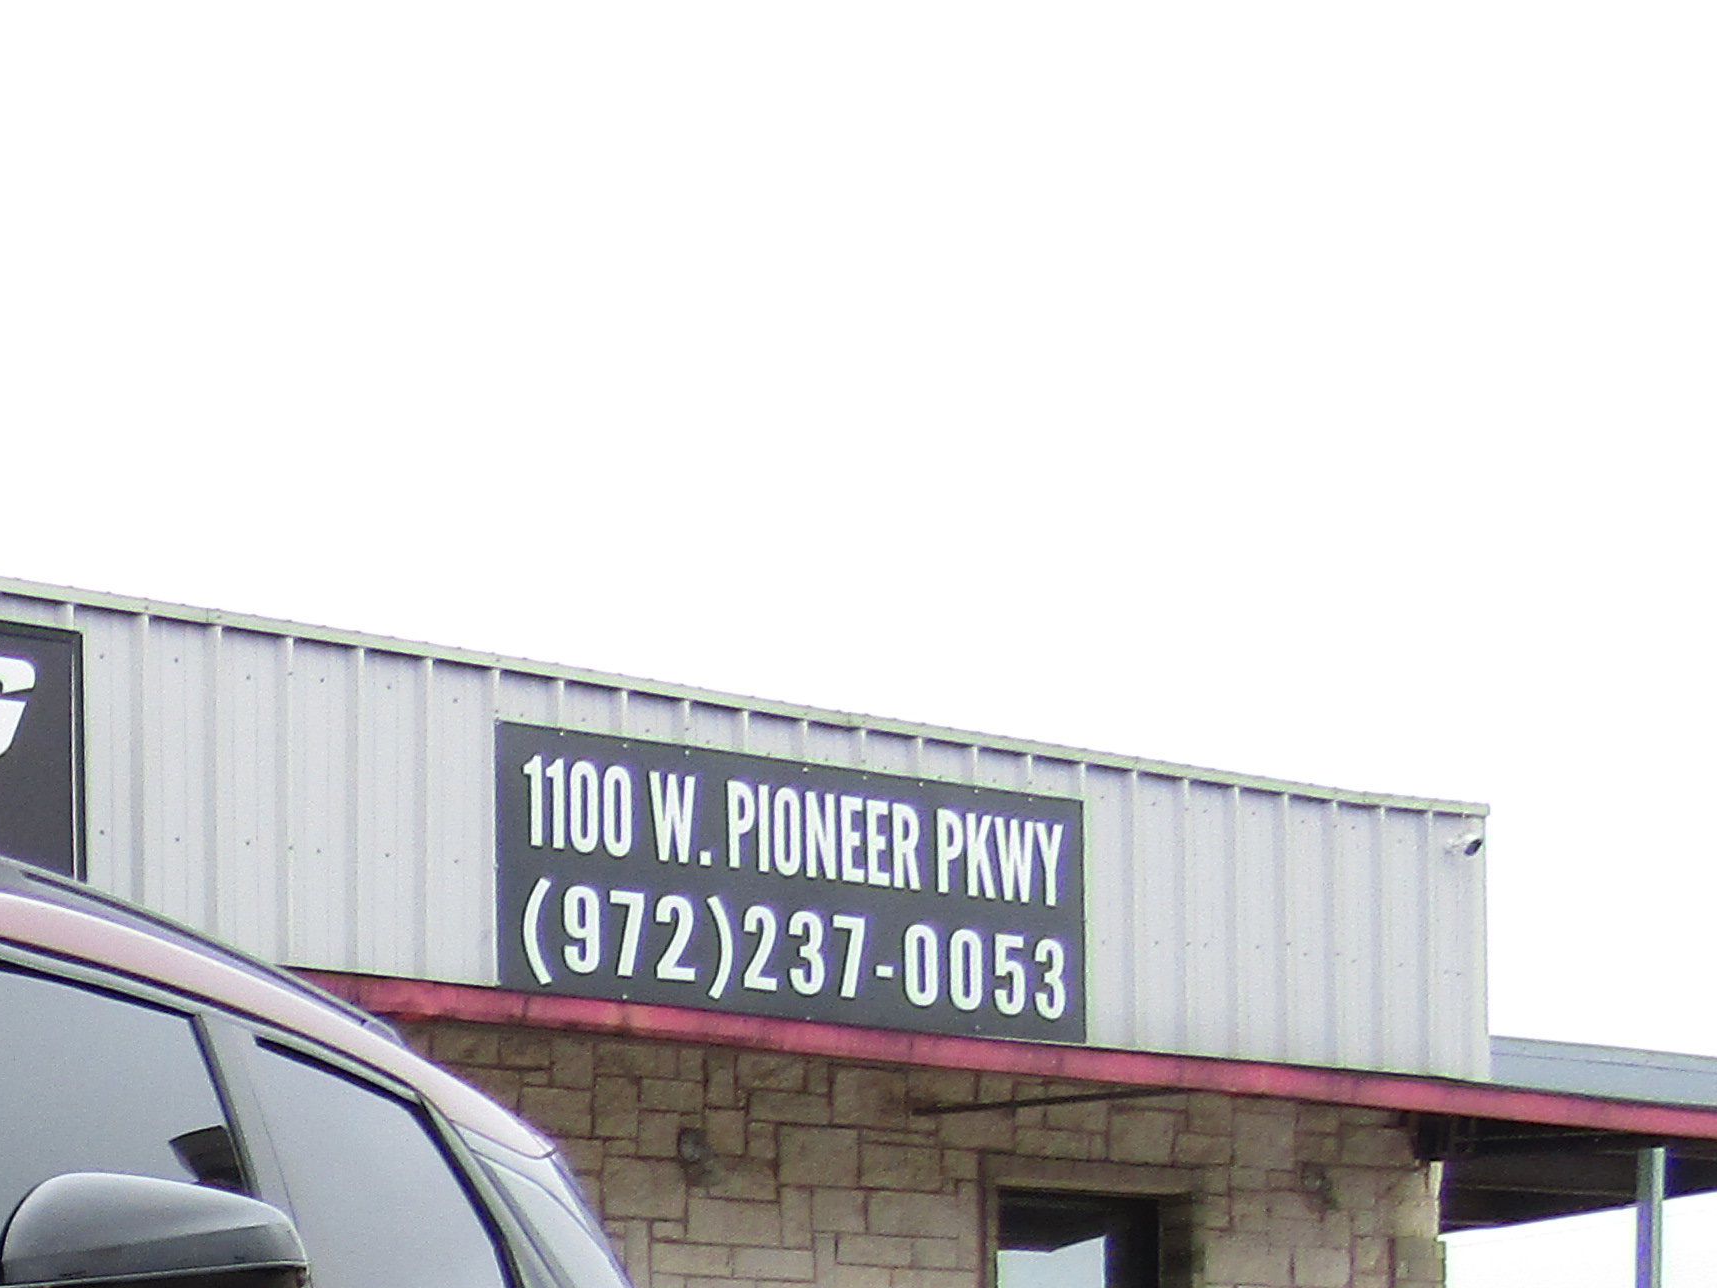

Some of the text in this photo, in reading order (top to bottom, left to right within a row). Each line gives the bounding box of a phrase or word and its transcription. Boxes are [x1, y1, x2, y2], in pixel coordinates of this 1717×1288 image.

[522, 754, 1064, 906] 1100 W. PIONEER PKWY
[522, 877, 1067, 1021] (972)237-0053
